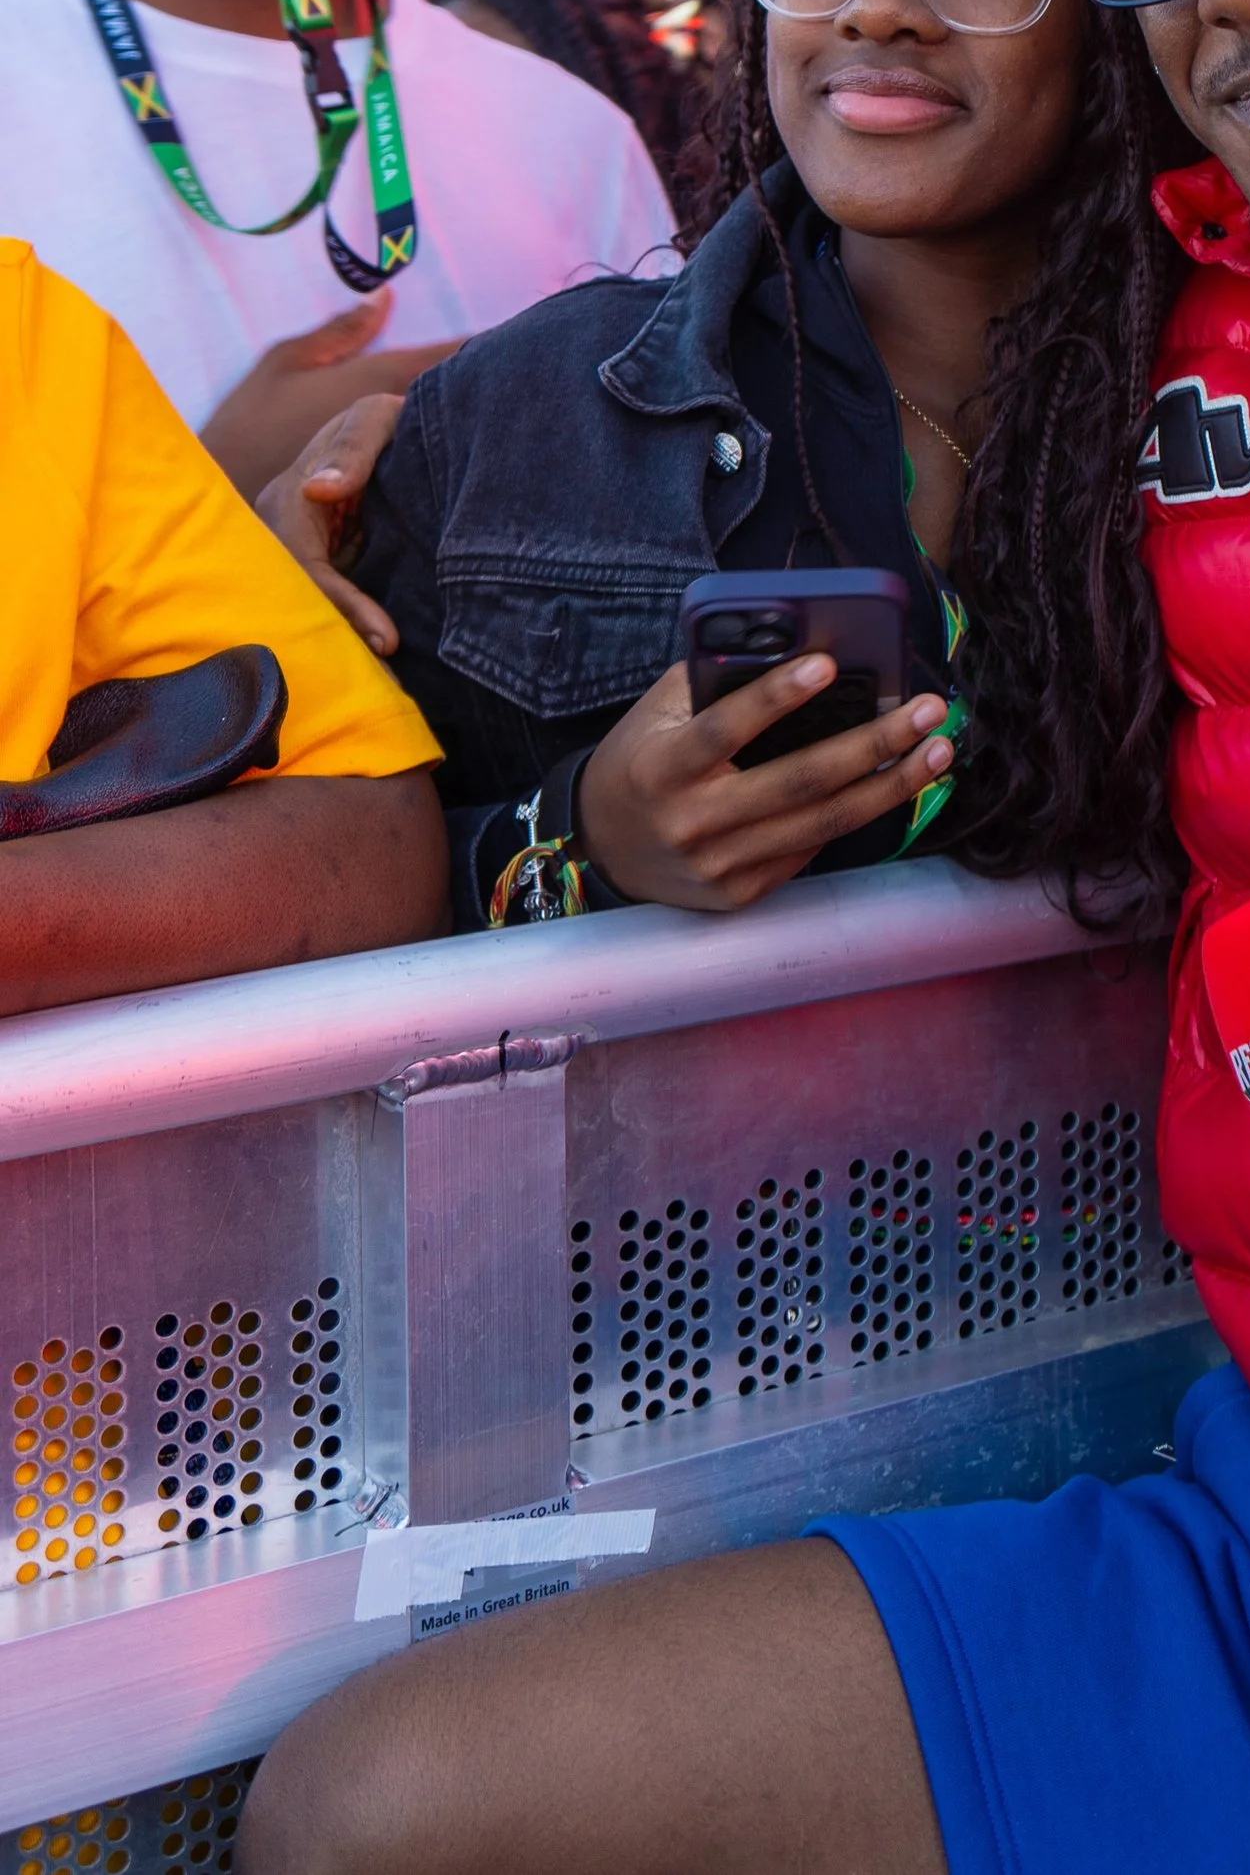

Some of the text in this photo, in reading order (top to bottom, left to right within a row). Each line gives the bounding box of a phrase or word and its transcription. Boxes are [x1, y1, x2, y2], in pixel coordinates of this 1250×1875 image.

[370, 91, 399, 184] JAMAICA
[420, 1579, 570, 1633] Made in Great Britain
